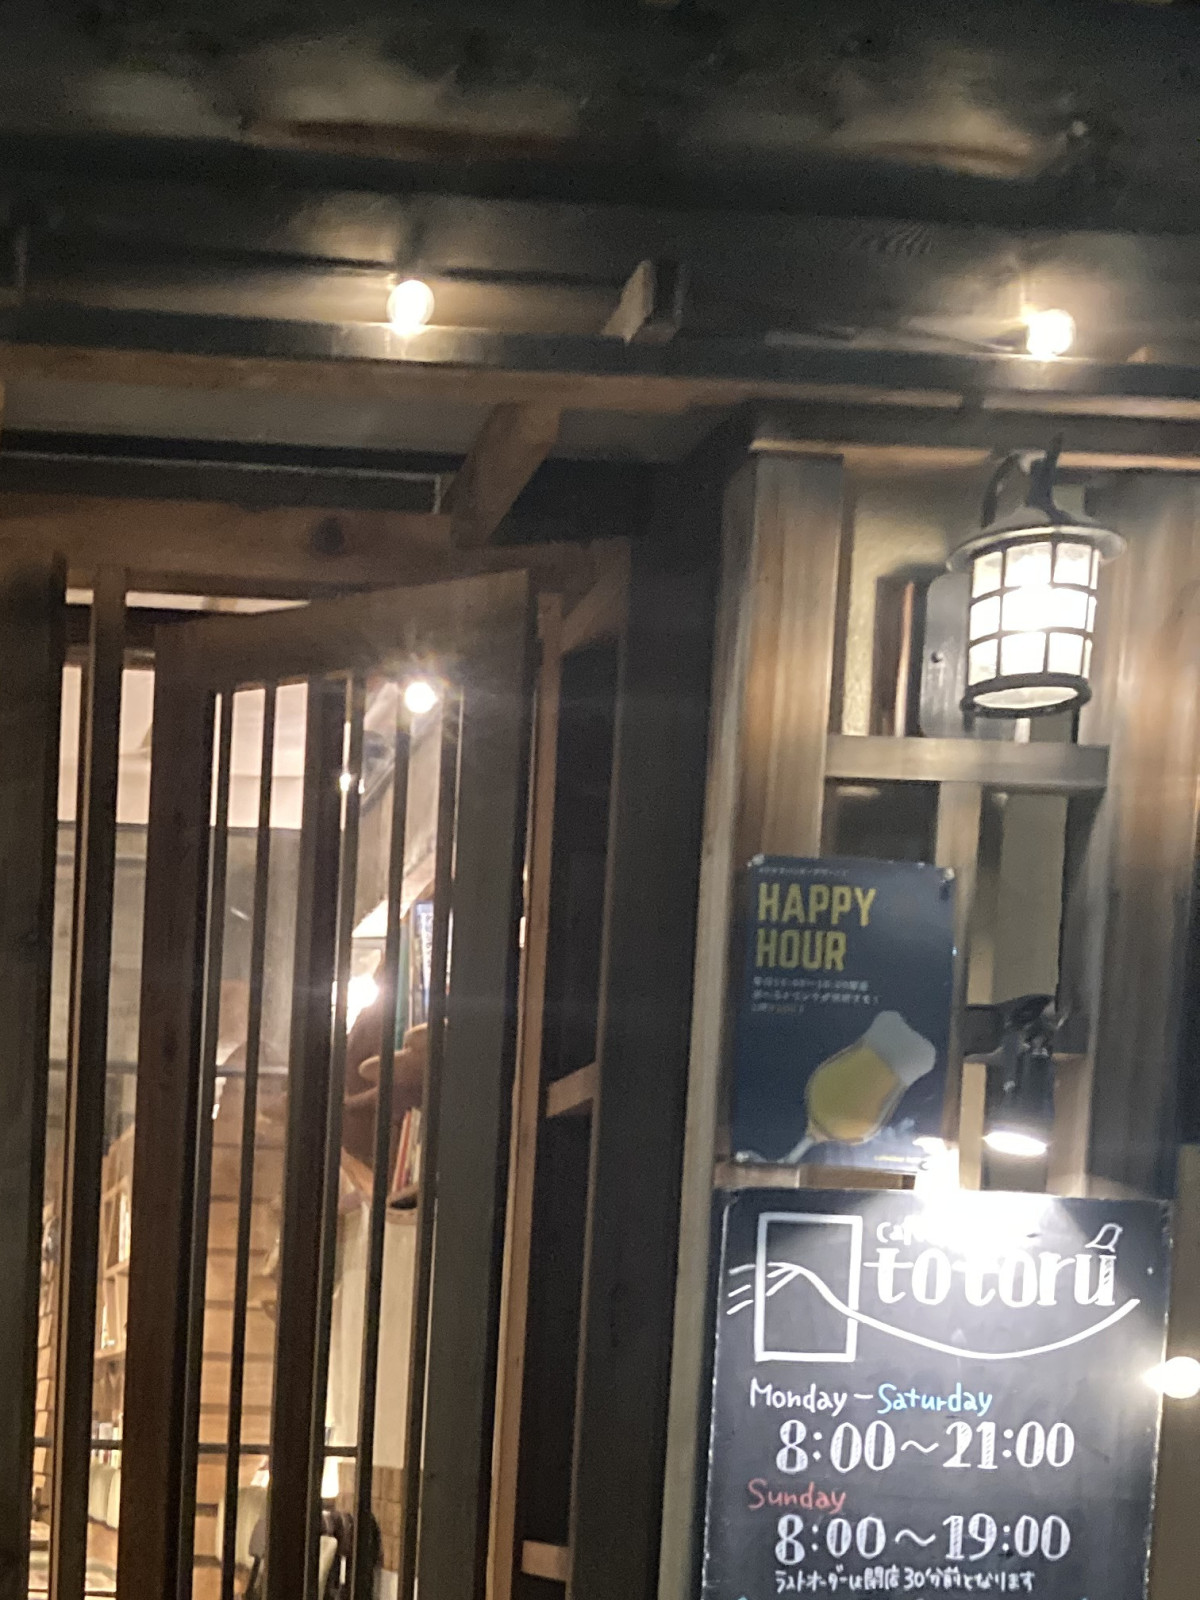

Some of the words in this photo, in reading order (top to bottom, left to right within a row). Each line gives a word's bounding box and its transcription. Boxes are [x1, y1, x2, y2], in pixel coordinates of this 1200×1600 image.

[758, 882, 877, 927] HAPPY
[756, 928, 847, 971] HOUR
[863, 1245, 1118, 1308] totoru
[747, 1478, 847, 1514] Sunday
